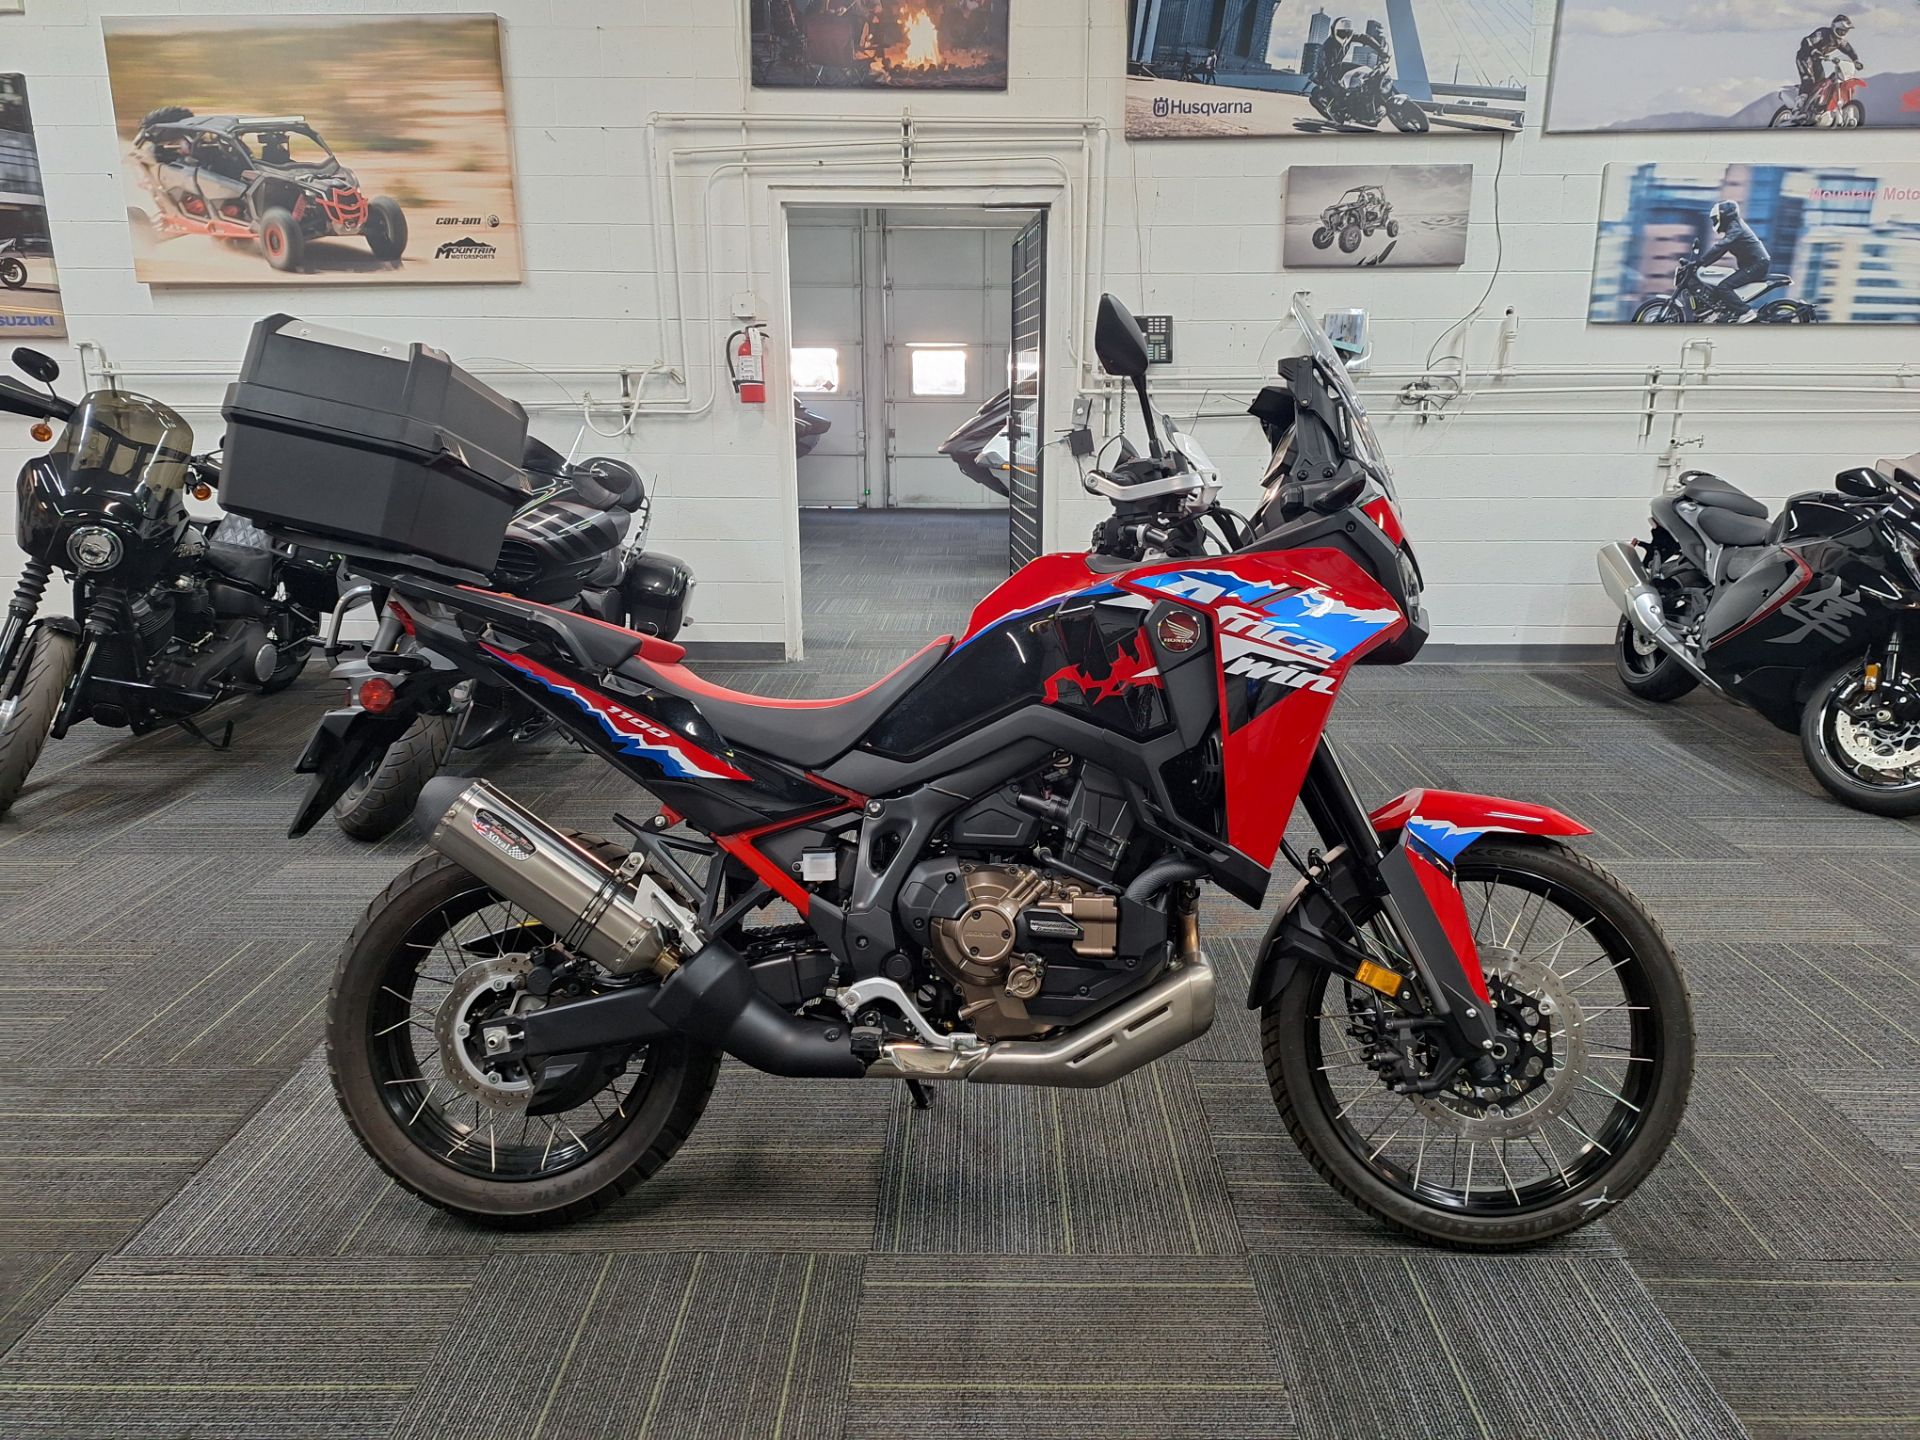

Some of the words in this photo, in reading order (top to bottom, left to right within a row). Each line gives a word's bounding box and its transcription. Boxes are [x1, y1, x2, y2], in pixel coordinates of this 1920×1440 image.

[1170, 99, 1253, 116] Husqvarna
[435, 217, 482, 225] can-am
[0, 315, 55, 326] SUZUKI
[606, 705, 671, 738] 1100
[487, 831, 511, 851] XOval
